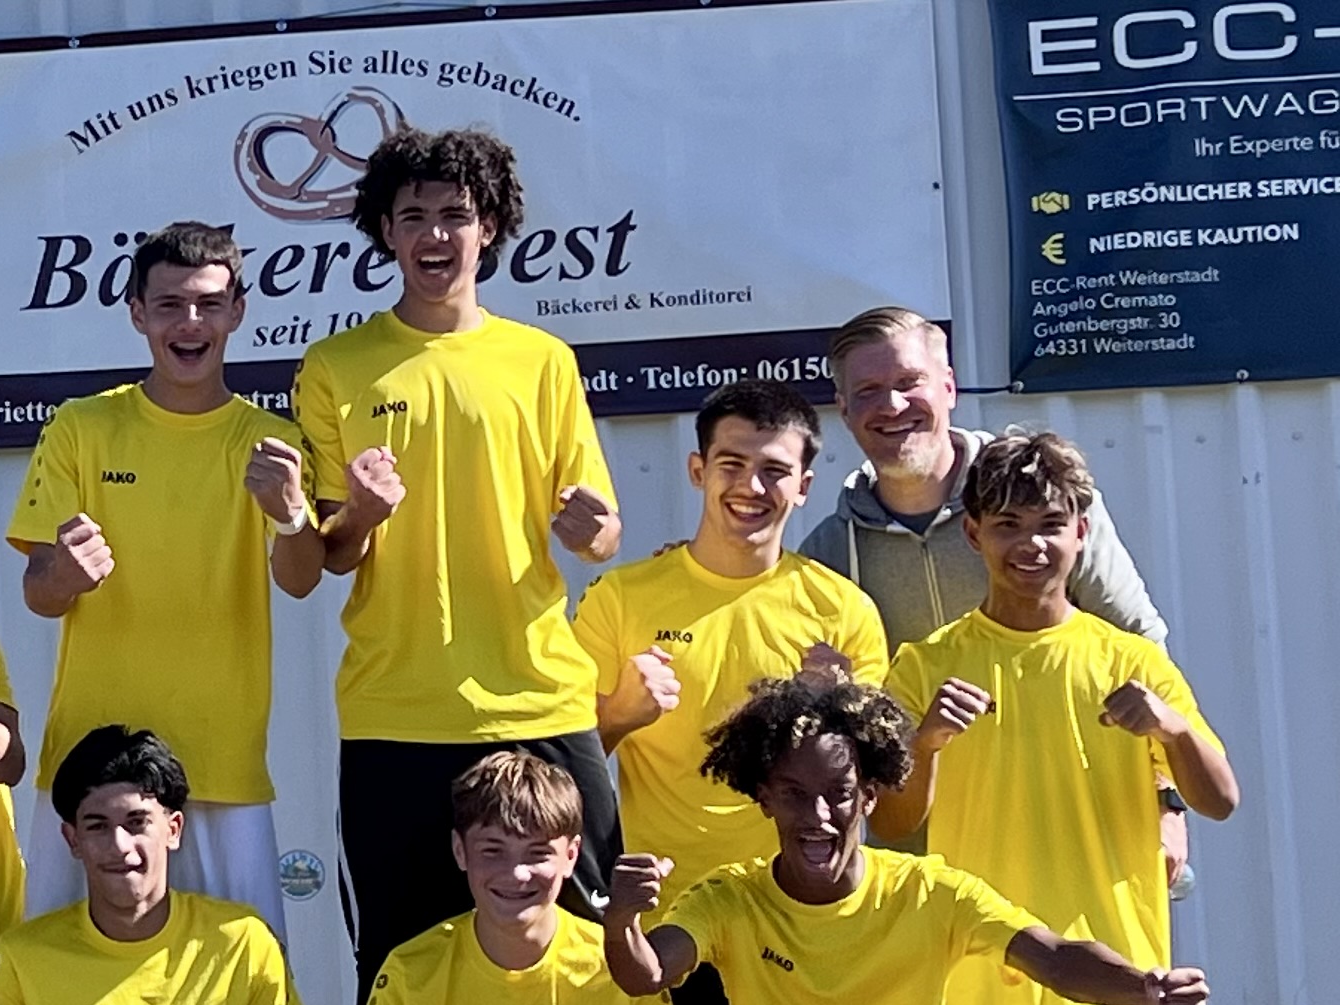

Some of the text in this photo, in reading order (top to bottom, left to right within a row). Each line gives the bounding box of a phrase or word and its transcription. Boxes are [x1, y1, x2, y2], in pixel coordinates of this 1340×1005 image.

[65, 50, 581, 155] Mit uns kriegen Sie alles gebacken.
[1056, 89, 1340, 132] SPORTWAG
[1194, 137, 1222, 157] Ihr
[1229, 135, 1313, 158] Experte
[1087, 181, 1253, 211] PERSÖNLICHER
[485, 209, 637, 283] est
[1089, 223, 1299, 253] NIEDRIGE KAUTION
[1031, 266, 1220, 296] ECC-Rent Weiterstadt
[537, 286, 752, 316] Bäckerei & Konditorei
[1032, 295, 1096, 317] Angelo
[253, 315, 312, 347] seit
[1158, 312, 1180, 329] 30
[1034, 334, 1195, 358] 64331 Weiterstadt
[641, 366, 748, 390] Telefon:
[371, 401, 407, 418] JAKO
[101, 470, 136, 484] JAKO
[655, 630, 693, 643] JAKO
